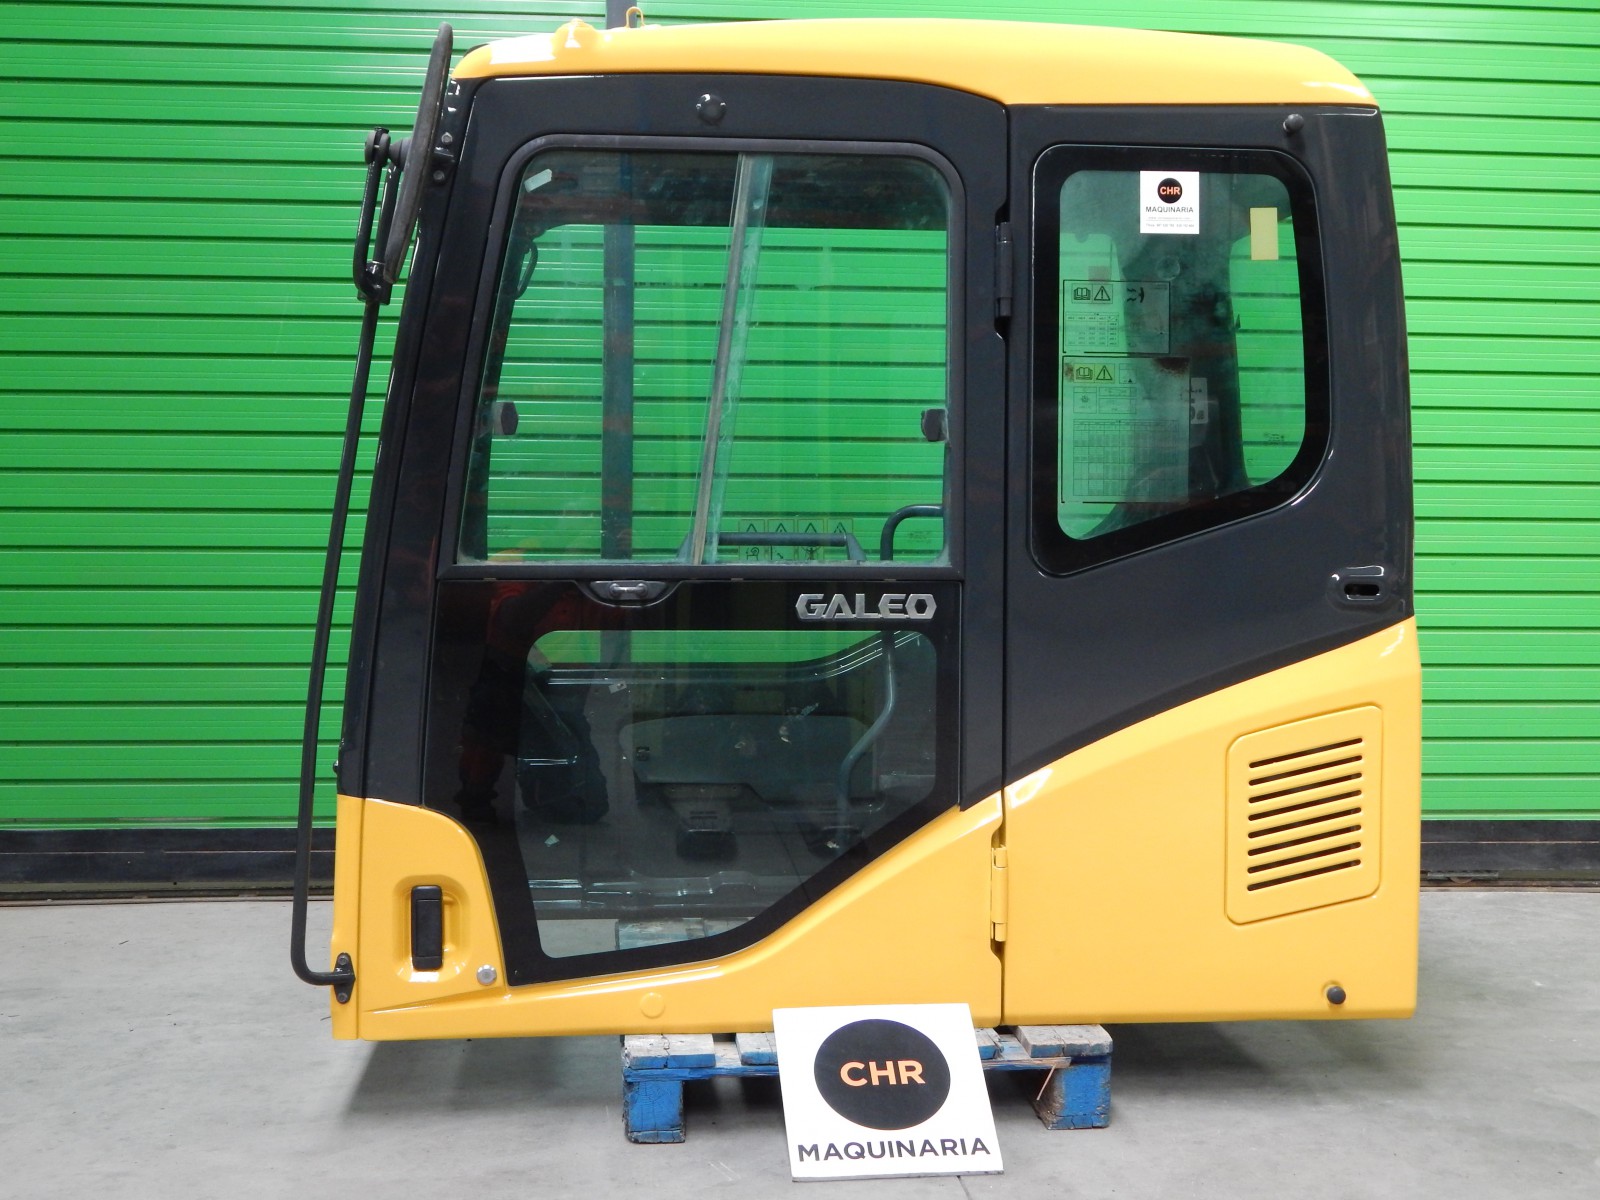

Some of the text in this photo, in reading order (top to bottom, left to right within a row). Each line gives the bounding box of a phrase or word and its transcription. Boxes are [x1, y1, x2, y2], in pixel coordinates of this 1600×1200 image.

[1159, 186, 1181, 195] CHR
[795, 593, 938, 619] GALEO
[840, 1060, 926, 1087] CHR
[797, 1137, 991, 1162] MAQUINARIA
